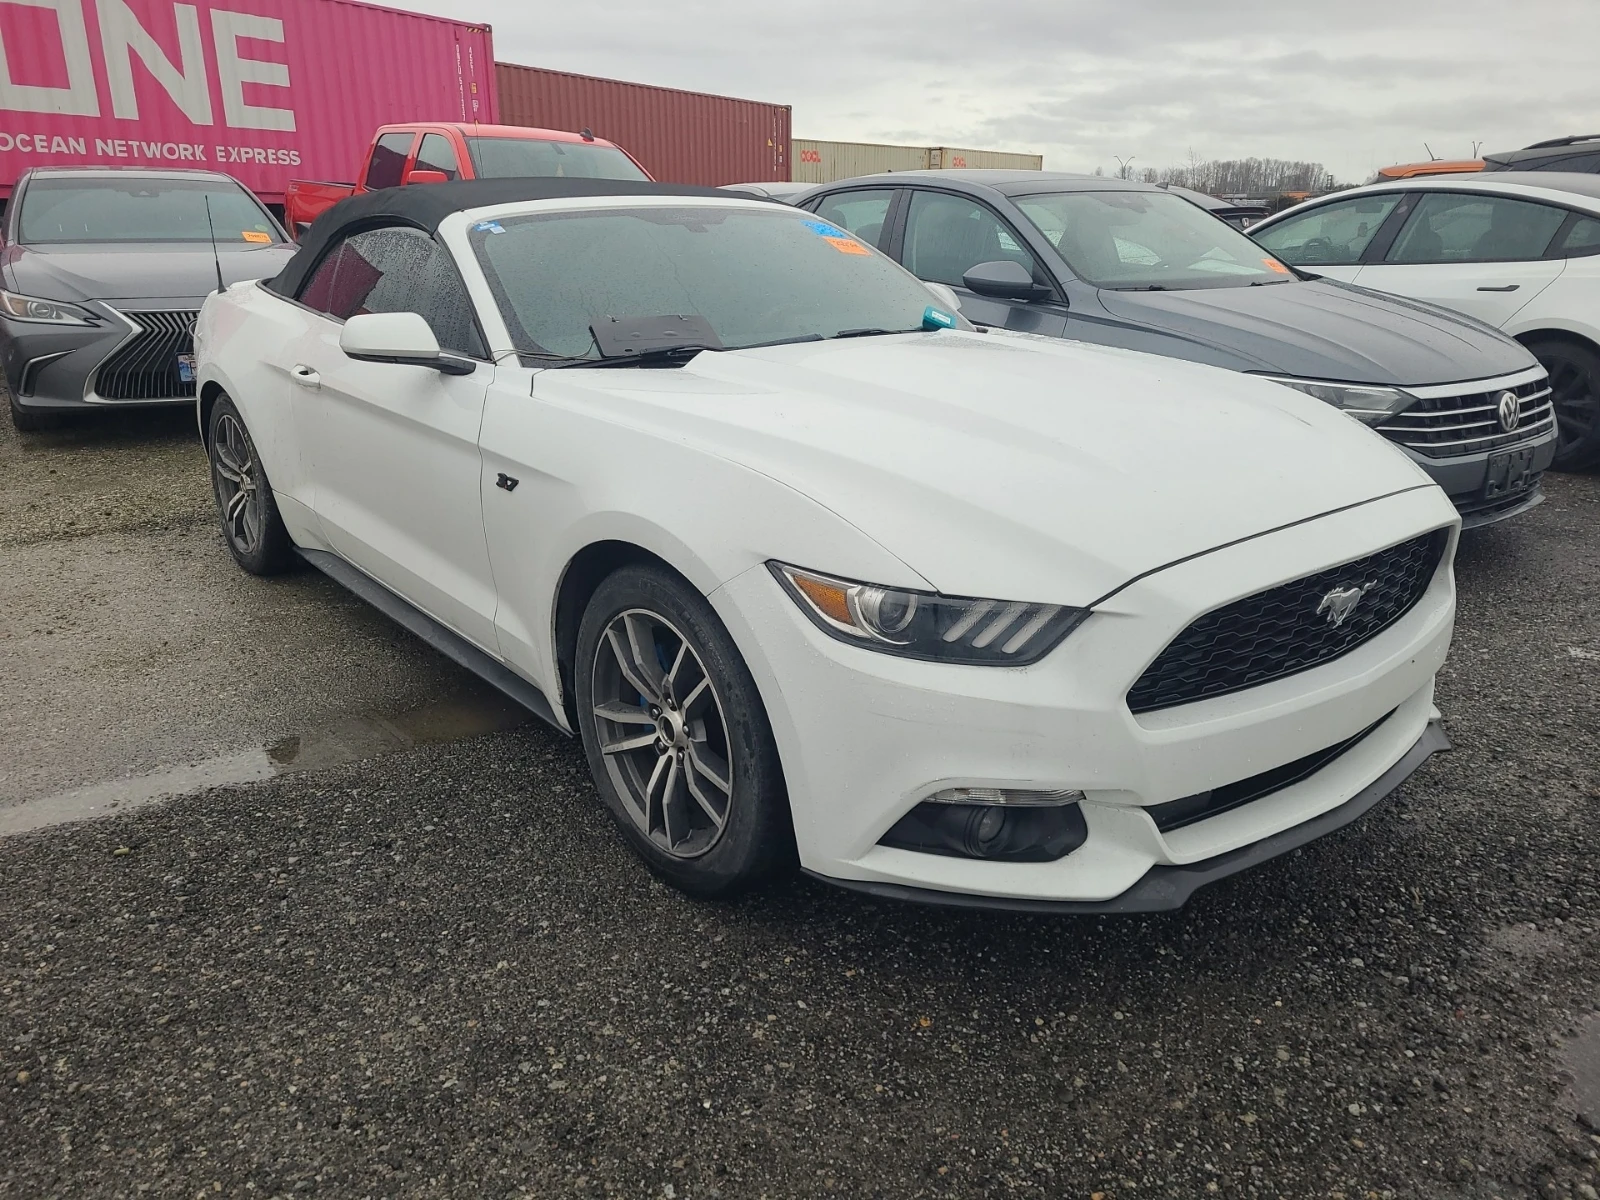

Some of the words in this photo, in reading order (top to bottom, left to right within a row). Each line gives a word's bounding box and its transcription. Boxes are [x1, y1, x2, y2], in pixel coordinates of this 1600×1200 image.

[0, 0, 296, 132] ONE
[0, 132, 87, 155] OCEAN
[95, 138, 207, 161] NETWORK
[216, 145, 301, 166] EXPRESS
